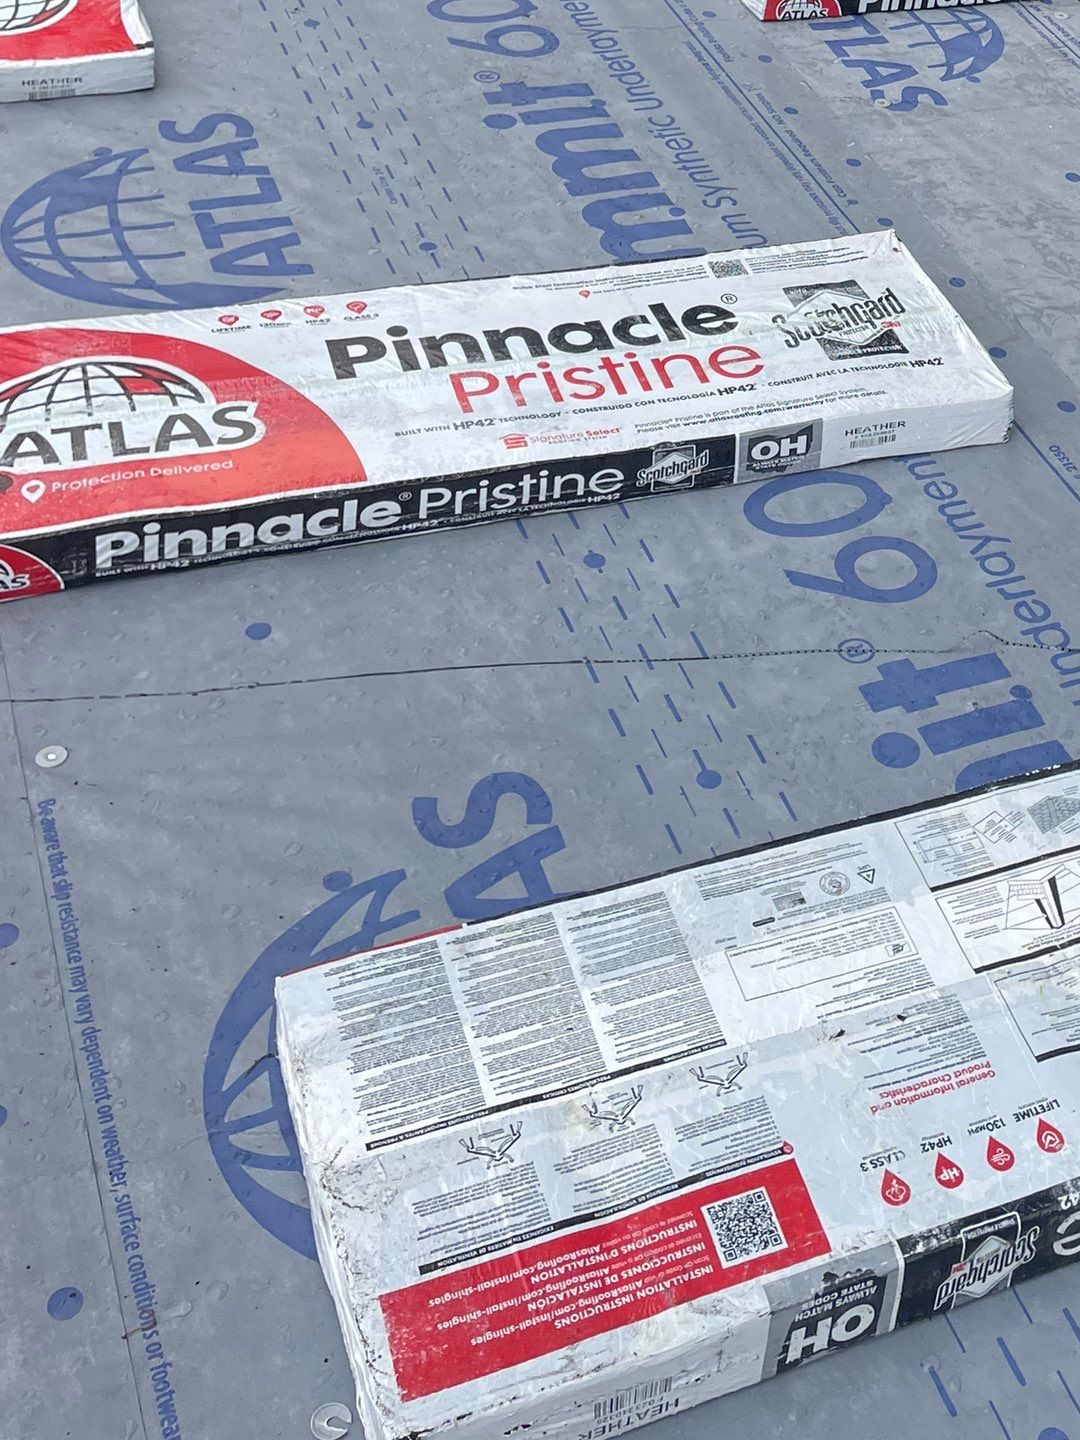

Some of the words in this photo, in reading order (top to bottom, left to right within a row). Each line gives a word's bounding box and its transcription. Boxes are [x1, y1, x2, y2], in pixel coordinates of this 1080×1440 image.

[783, 9, 828, 20] ATLAS
[22, 76, 84, 88] HEATHER
[648, 116, 738, 208] Synthetic
[158, 113, 314, 277] ATLAS
[772, 287, 906, 348] Scotchgard
[325, 302, 738, 380] Pinnacle
[450, 344, 765, 414] Pristine
[395, 428, 422, 438] BUILT
[424, 425, 451, 433] WITH
[452, 419, 496, 432] HP42
[499, 411, 562, 423] TECHNOLOGY
[572, 403, 633, 415] CONSTRUIDO
[634, 399, 656, 408] CON
[717, 383, 758, 397] HP42
[767, 373, 814, 387] CONSTRUIT
[816, 369, 838, 379] AVEC
[850, 361, 909, 373] TECHNOLOGIE
[909, 357, 945, 368] HP42
[0, 405, 258, 468] ATLAS
[585, 427, 622, 437] Select
[845, 420, 906, 437] HEATHER
[751, 435, 809, 460] OH
[1049, 444, 1078, 473] 21350
[51, 469, 146, 493] Protection
[150, 460, 234, 477] Delivered
[636, 449, 710, 488] Scotchgard
[95, 499, 401, 569] Pinnacle
[419, 469, 624, 519] Pristine
[743, 471, 938, 603] 60
[37, 798, 56, 817] Be
[40, 816, 60, 852] aware
[48, 850, 69, 879] that
[57, 901, 83, 966] resistance
[69, 964, 90, 994] may
[74, 993, 94, 1025] vary
[79, 1025, 113, 1106] dependent
[955, 1060, 991, 1077] Product
[963, 1069, 996, 1086] General
[879, 1073, 952, 1100] Characteristics
[893, 1080, 956, 1107] Information
[96, 1104, 114, 1124] on
[870, 1102, 892, 1115] and
[1013, 1099, 1061, 1123] LIFETIME
[100, 1124, 130, 1193] weather,
[869, 1150, 907, 1169] CLASS
[920, 1135, 953, 1154] HP42
[114, 1193, 141, 1253] surface
[621, 1219, 697, 1255] INSTRUCTIONS
[428, 1244, 600, 1308] AtlasRoofing.com/install-shingles
[531, 1247, 619, 1284] D'INSTALLATION
[621, 1241, 706, 1280] INSTRUCCIONES
[934, 1225, 1041, 1311] Scotchgard
[604, 1271, 619, 1286] DE
[638, 1264, 714, 1300] INSTALLATION
[838, 1279, 874, 1297] STATE
[127, 1254, 159, 1341] conditions
[437, 1266, 610, 1332] AtlasRoofing.com/install-shingles
[527, 1280, 603, 1312] INSTALACIÓN
[555, 1295, 634, 1329] INSTRUCTIONS
[794, 1301, 835, 1323] MATCH
[801, 1291, 839, 1309] CODES
[836, 1284, 878, 1307] ALWAYS
[470, 1279, 643, 1347] AtlasRoofing.com/install-shingles
[786, 1304, 876, 1364] OH
[145, 1341, 164, 1361] or
[578, 1397, 680, 1440] HEATHER
